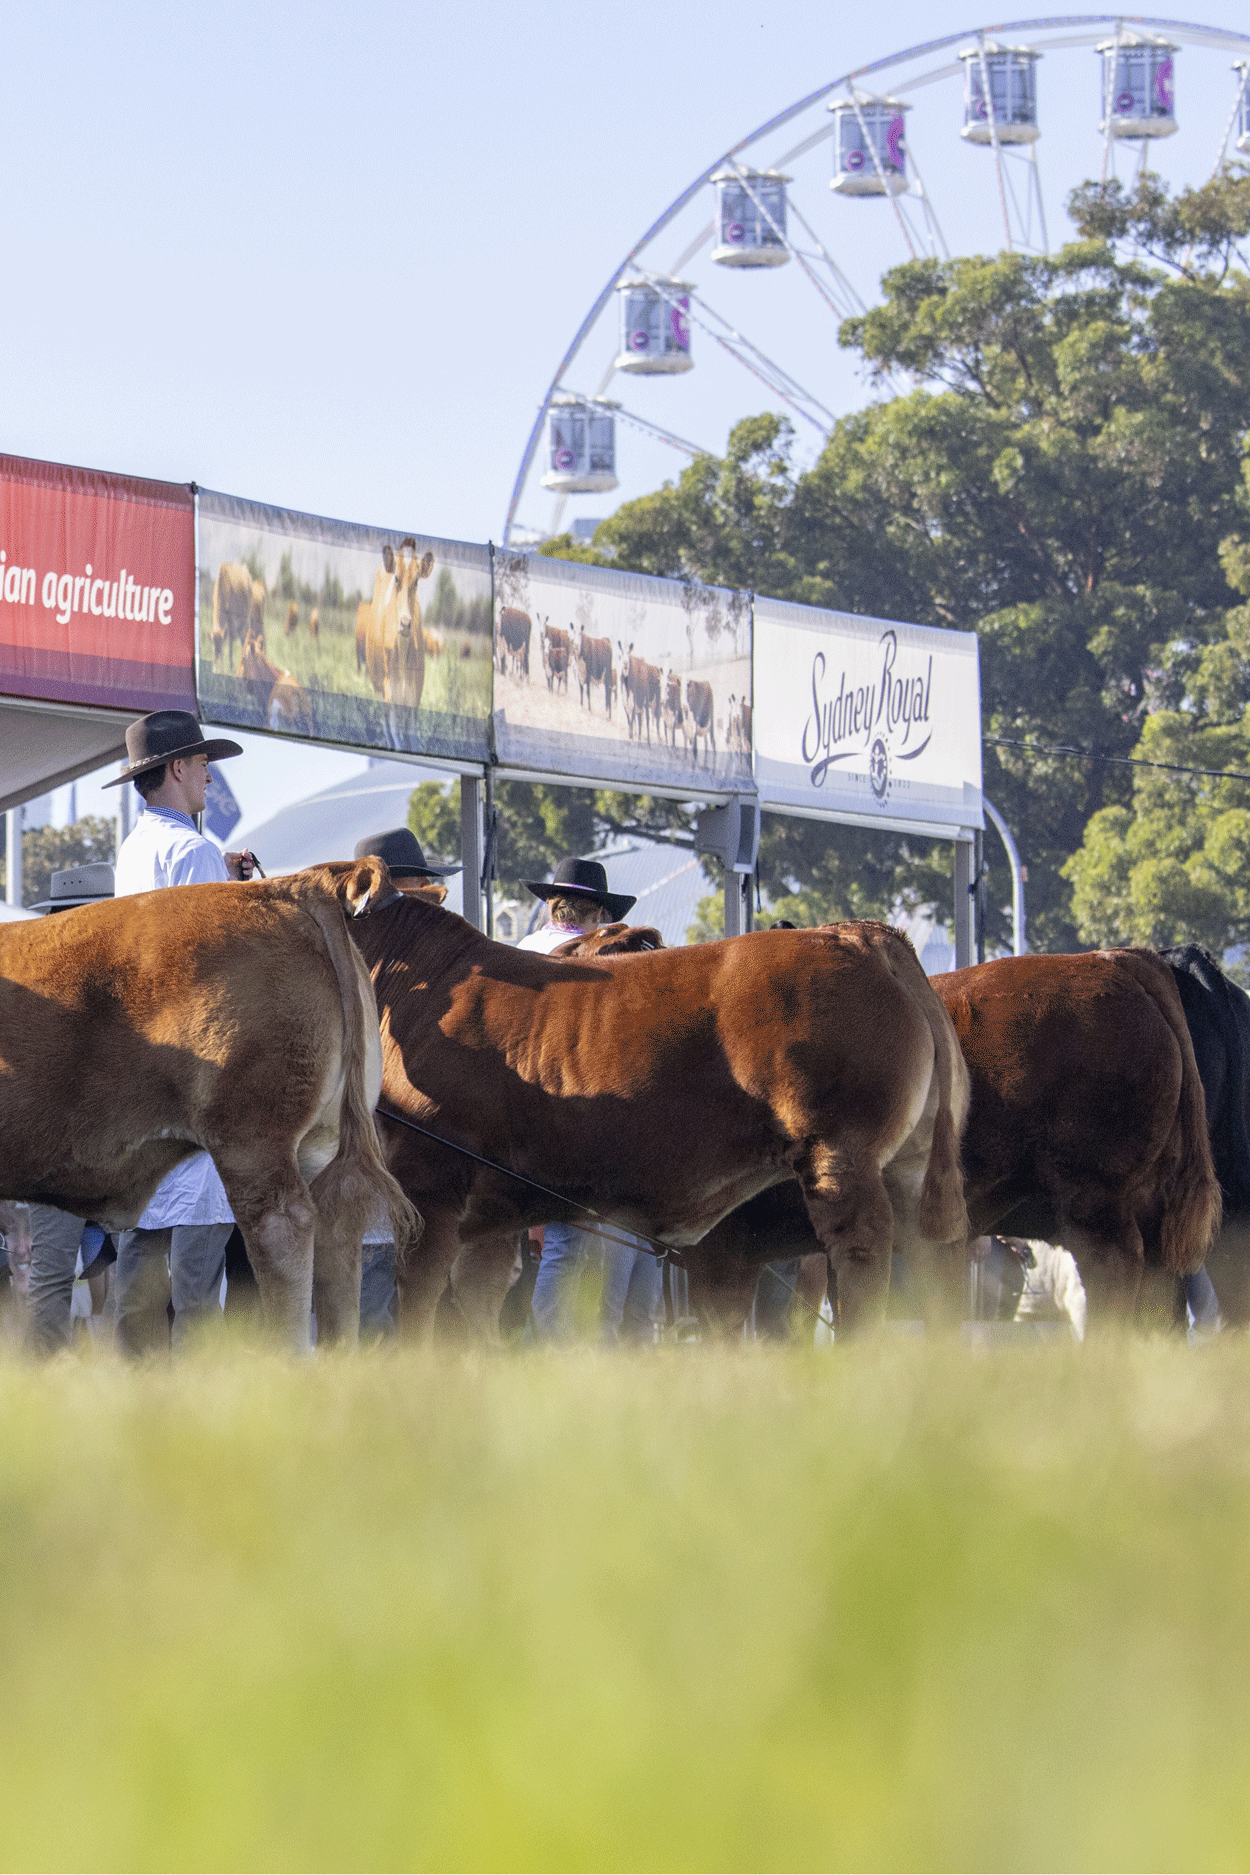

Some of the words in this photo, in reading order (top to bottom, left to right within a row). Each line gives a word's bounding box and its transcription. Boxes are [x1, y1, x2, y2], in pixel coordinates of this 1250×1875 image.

[42, 564, 174, 625] agriculture
[802, 652, 876, 788] Sydney
[875, 630, 933, 746] Royal
